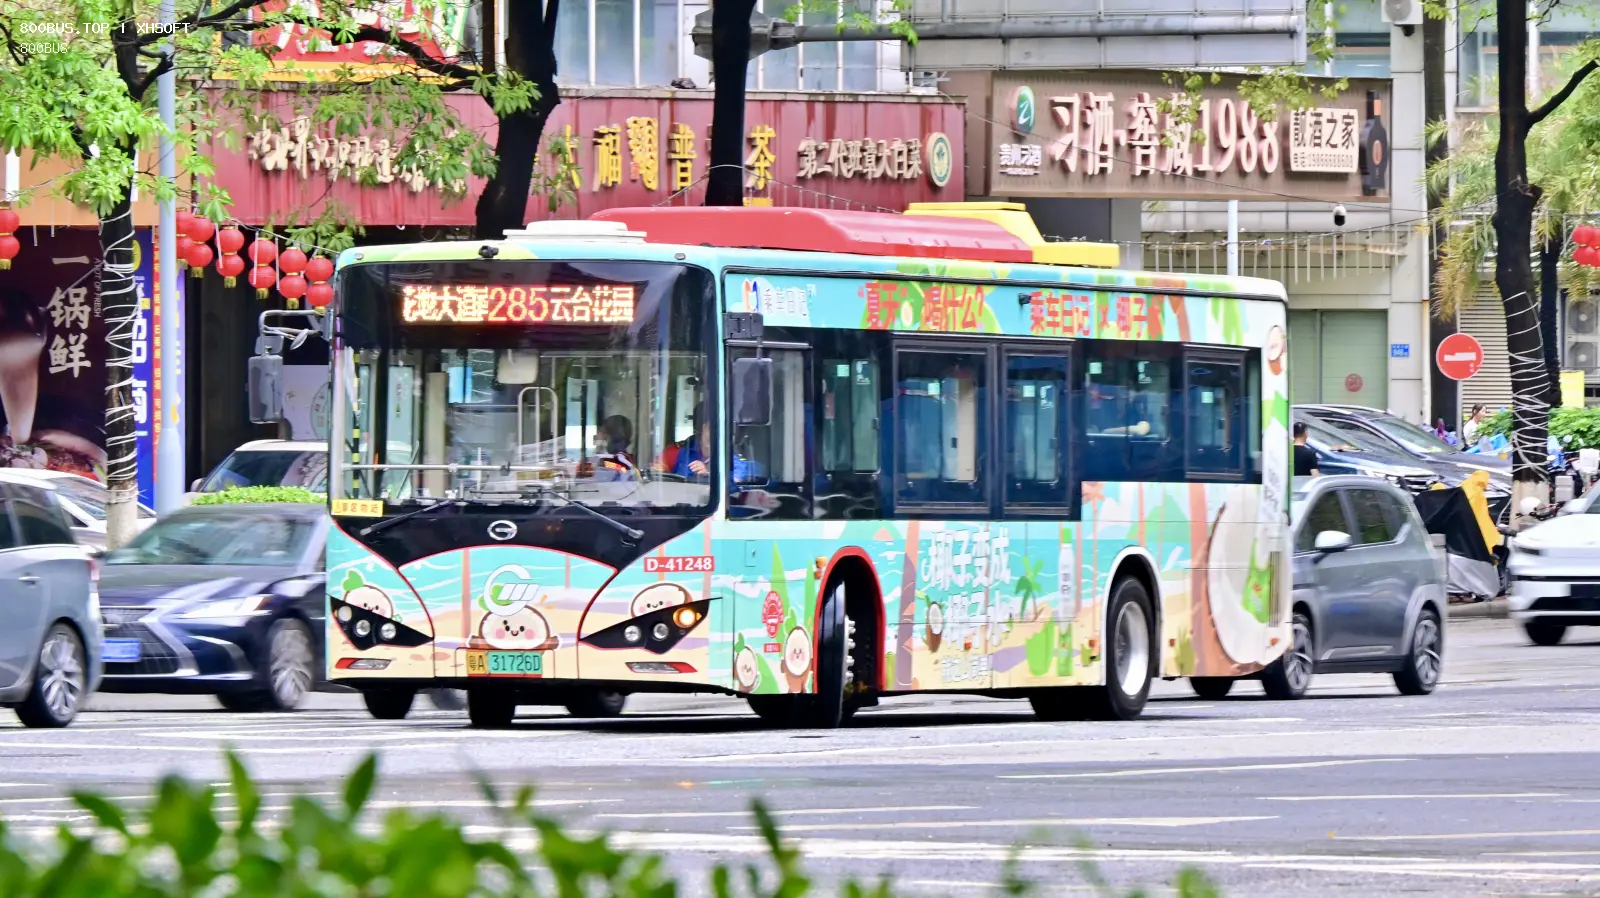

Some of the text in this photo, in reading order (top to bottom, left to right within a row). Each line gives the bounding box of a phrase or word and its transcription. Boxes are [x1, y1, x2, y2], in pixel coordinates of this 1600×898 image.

[797, 137, 923, 180] 第二代班章大白菜
[48, 254, 92, 378] 一锅鲜
[488, 287, 549, 322] 285
[1029, 290, 1090, 337] 乘车日记
[646, 557, 713, 572] D-41248
[926, 526, 1012, 592] 椰子变成
[491, 654, 541, 672] 31726D
